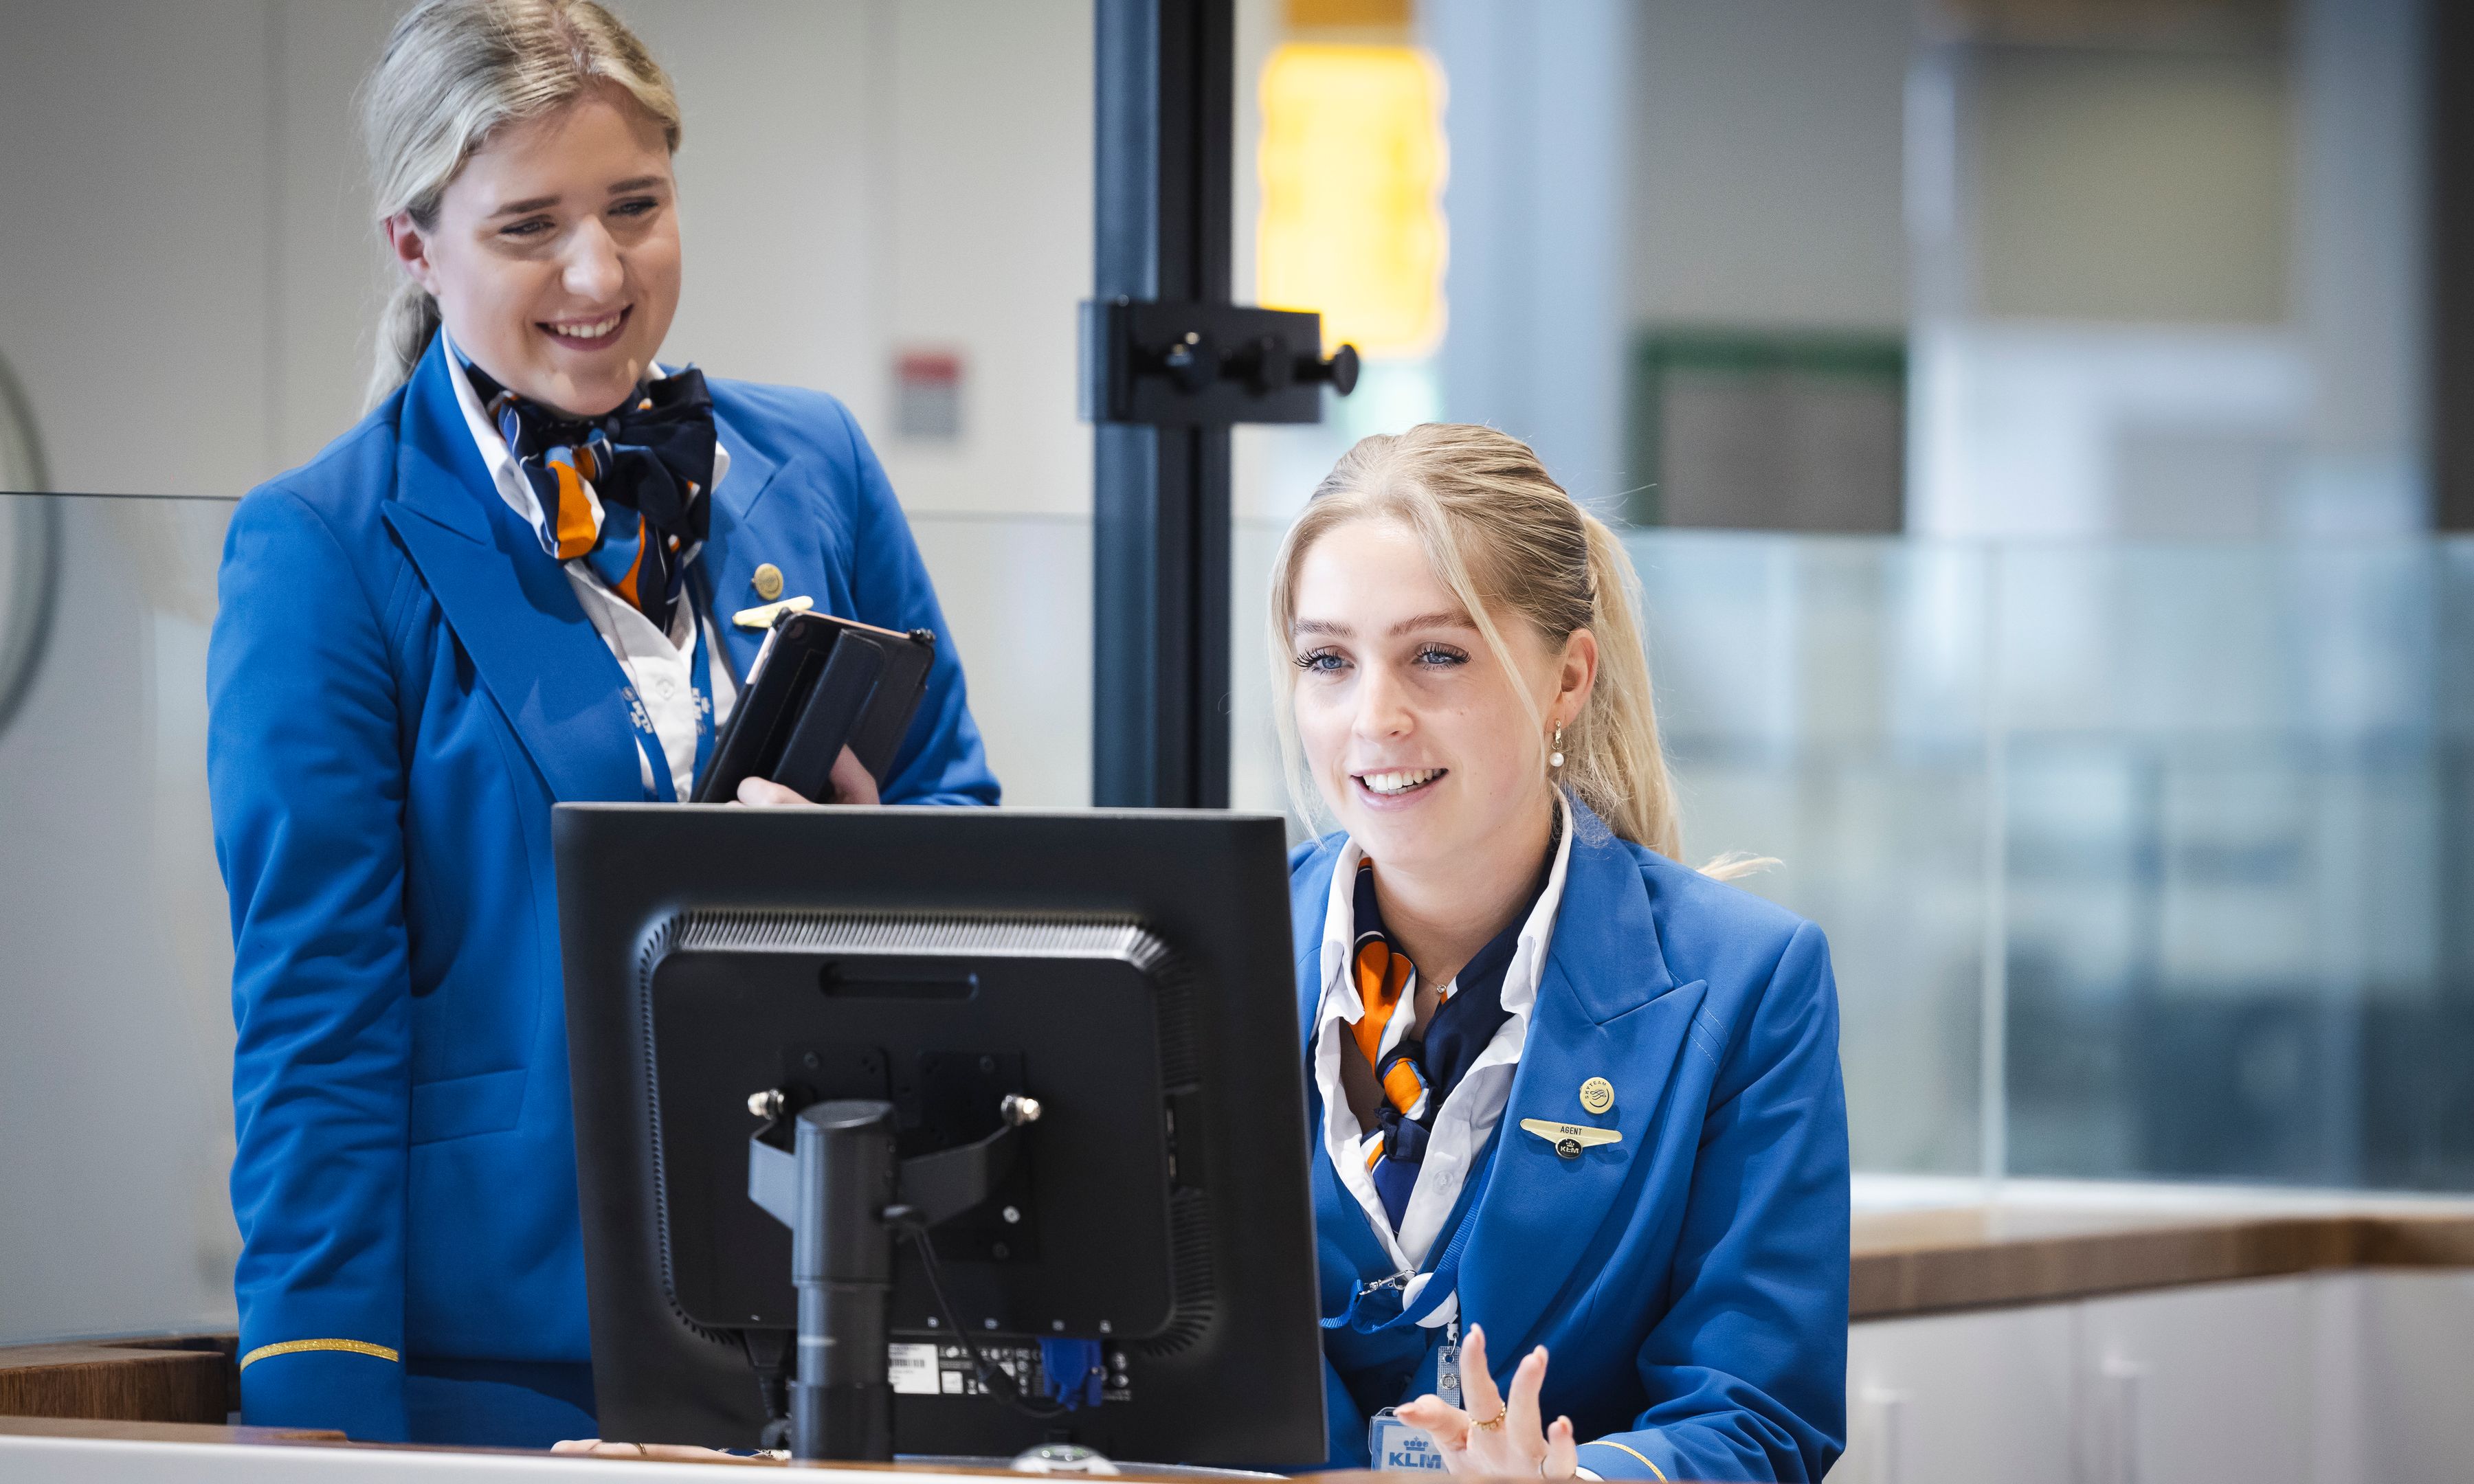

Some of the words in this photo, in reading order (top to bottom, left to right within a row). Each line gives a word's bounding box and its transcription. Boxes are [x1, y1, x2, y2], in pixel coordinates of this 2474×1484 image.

[1585, 1080, 1607, 1099] SKYTEAM
[1560, 1126, 1583, 1136] AGENT
[1389, 1452, 1442, 1469] KLM
